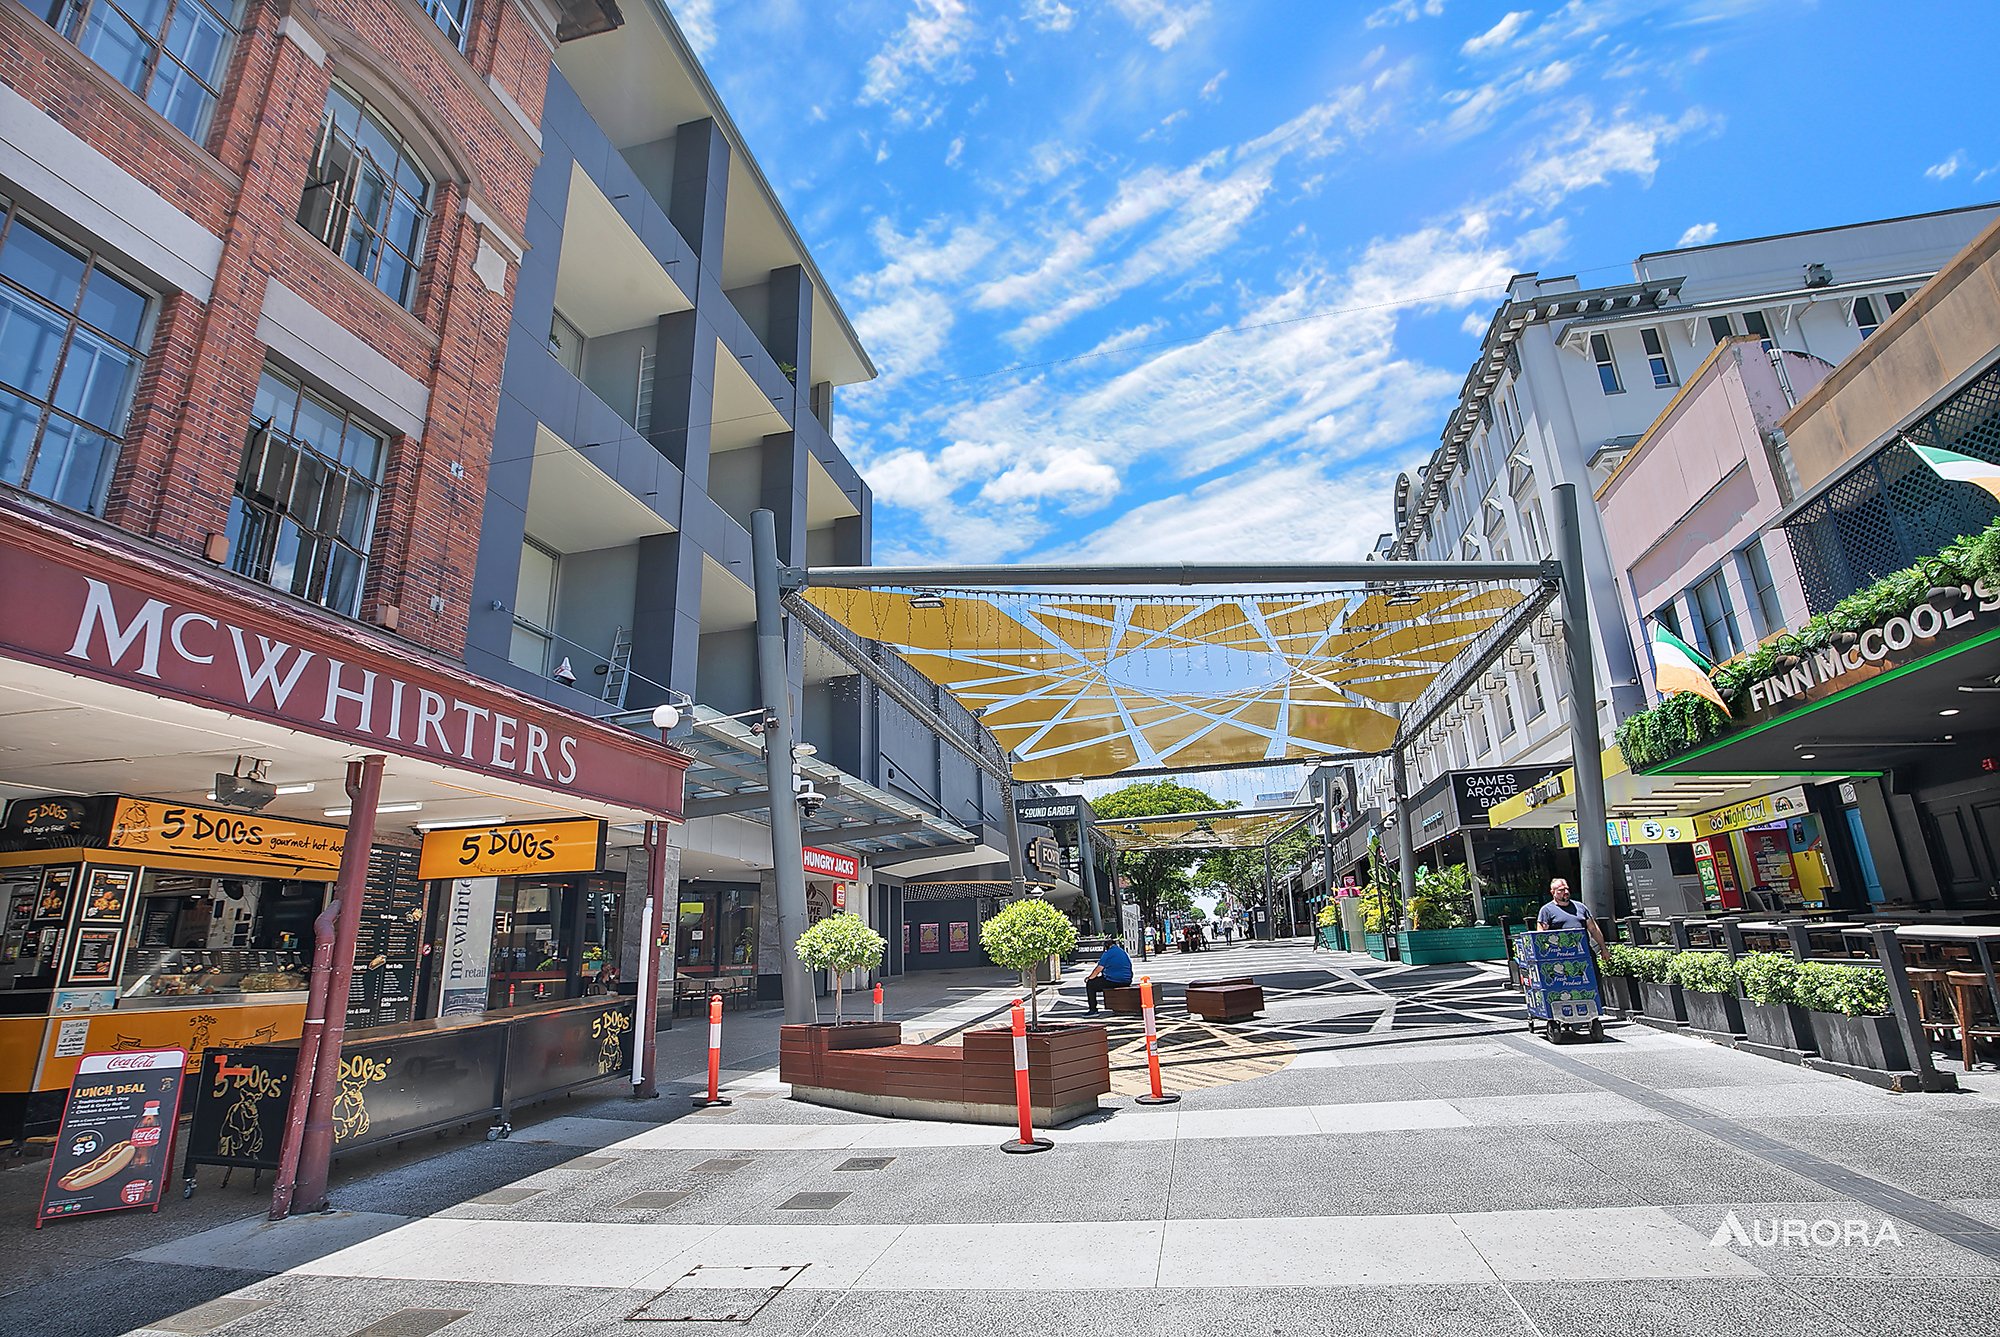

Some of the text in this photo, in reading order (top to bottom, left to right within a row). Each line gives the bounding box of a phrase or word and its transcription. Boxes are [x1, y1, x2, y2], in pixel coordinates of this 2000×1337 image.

[1749, 660, 1816, 713] FINN
[1466, 774, 1516, 786] GAMES
[1466, 784, 1519, 798] ARCADE
[27, 803, 69, 824] 5 DOGS
[1024, 807, 1047, 819] SOUND
[1047, 805, 1076, 817] GARDEN
[1724, 799, 1767, 827] NightOwl
[160, 809, 264, 845] 5 DOGS
[269, 837, 311, 850] gourmet
[313, 838, 328, 850] hot
[458, 835, 482, 865] 5
[803, 850, 835, 871] HUNGRY
[464, 966, 487, 979] retail
[61, 1002, 72, 1011] $3
[189, 1015, 219, 1027] 5 DOGS
[592, 1010, 630, 1039] 5 DOGS
[106, 1053, 158, 1071] Coca-Cola
[234, 1064, 282, 1098] DOGS
[74, 1083, 146, 1098] LUNCH DEAL
[71, 1141, 97, 1157] $9
[126, 1193, 140, 1203] $1
